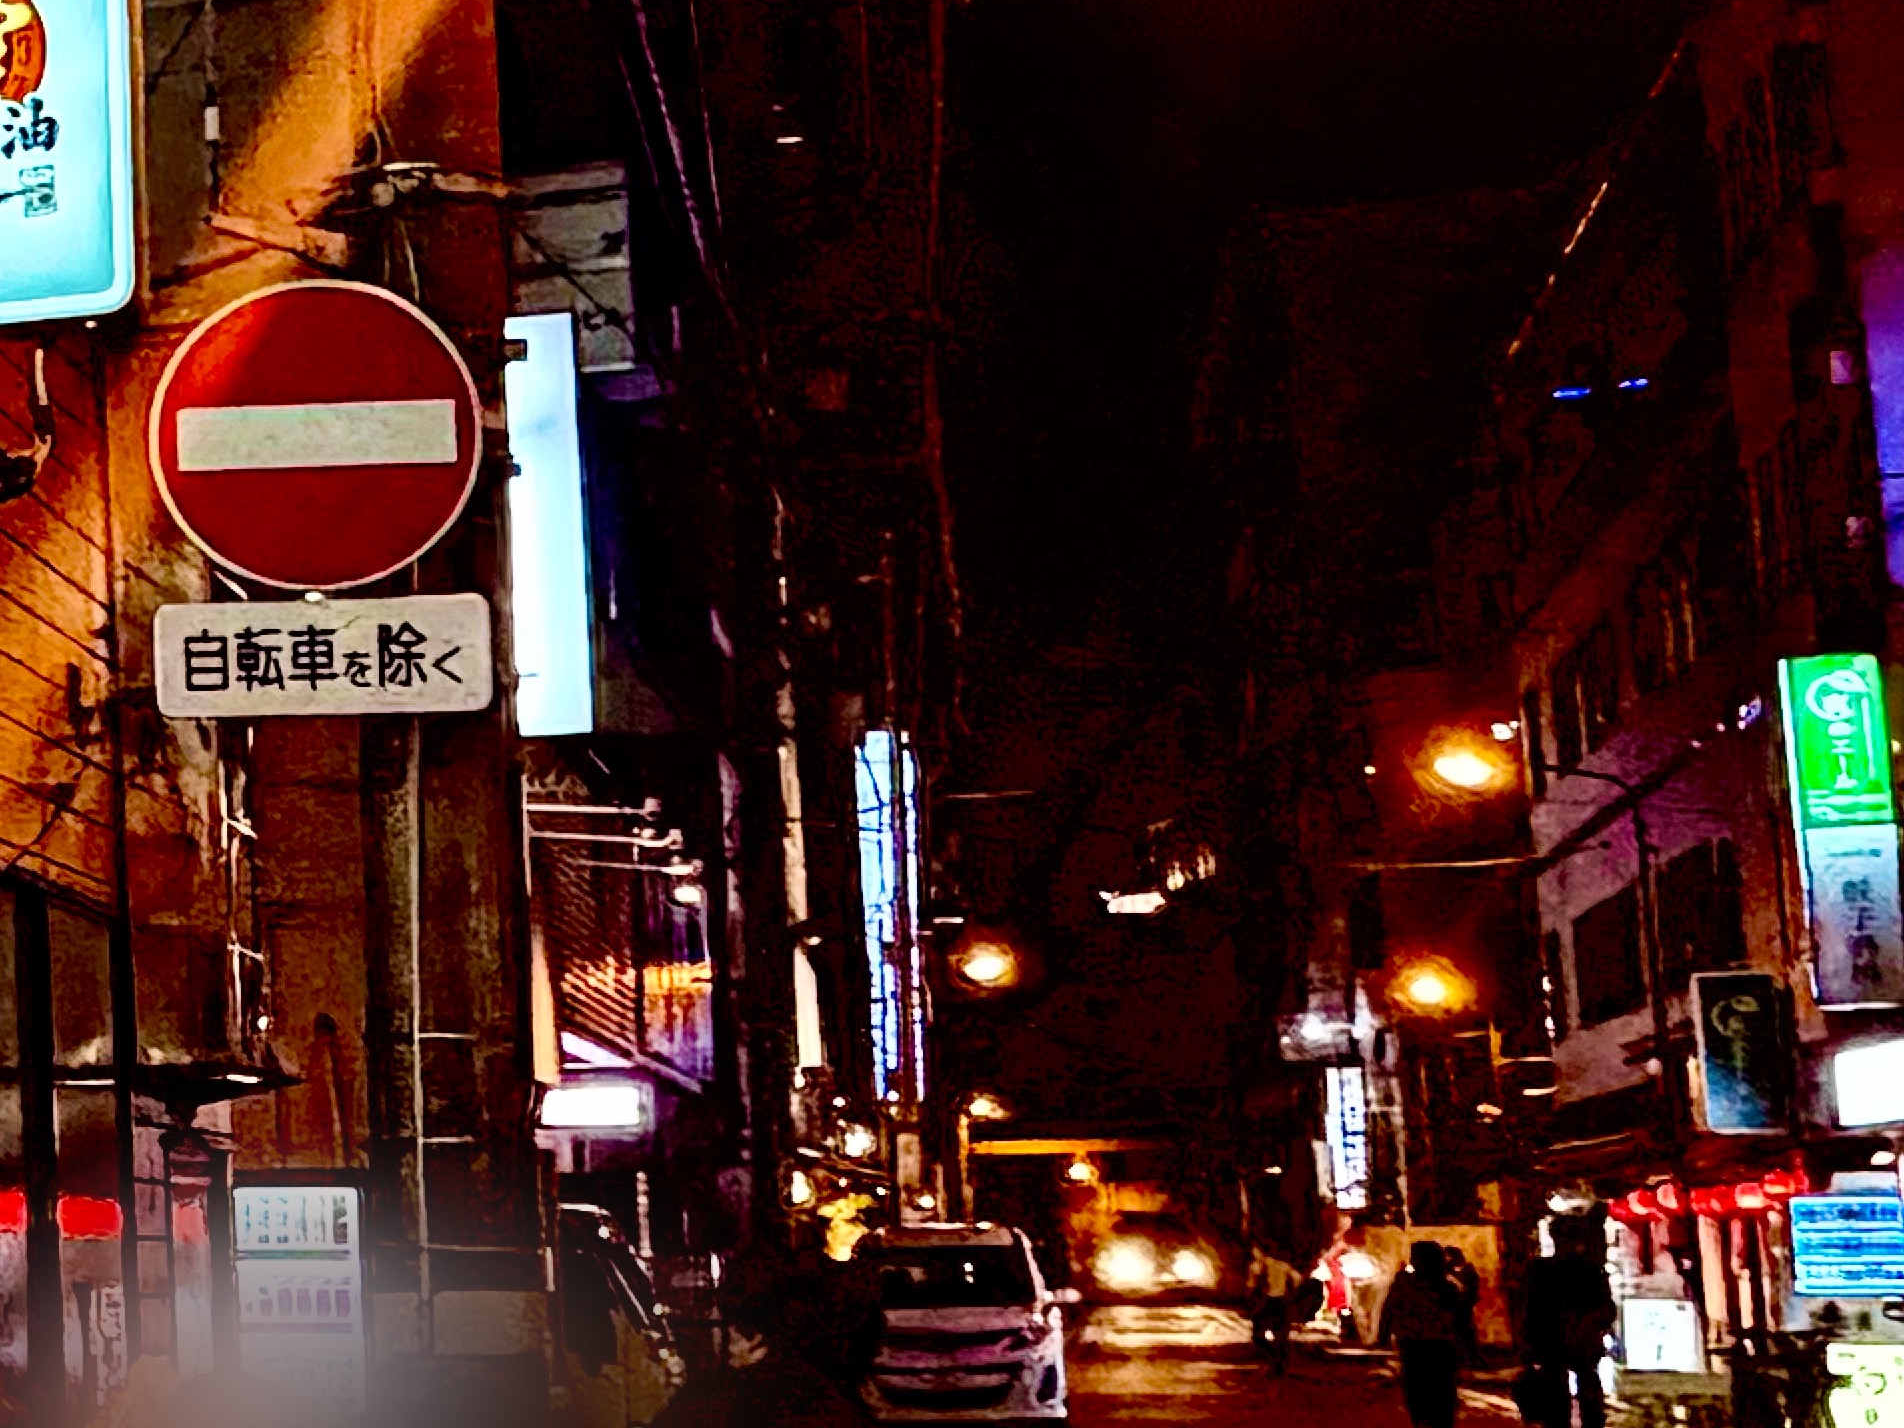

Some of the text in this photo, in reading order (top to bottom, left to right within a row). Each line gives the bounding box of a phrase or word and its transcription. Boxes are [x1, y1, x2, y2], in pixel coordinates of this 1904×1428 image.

[183, 622, 463, 692] 自転車を除く
